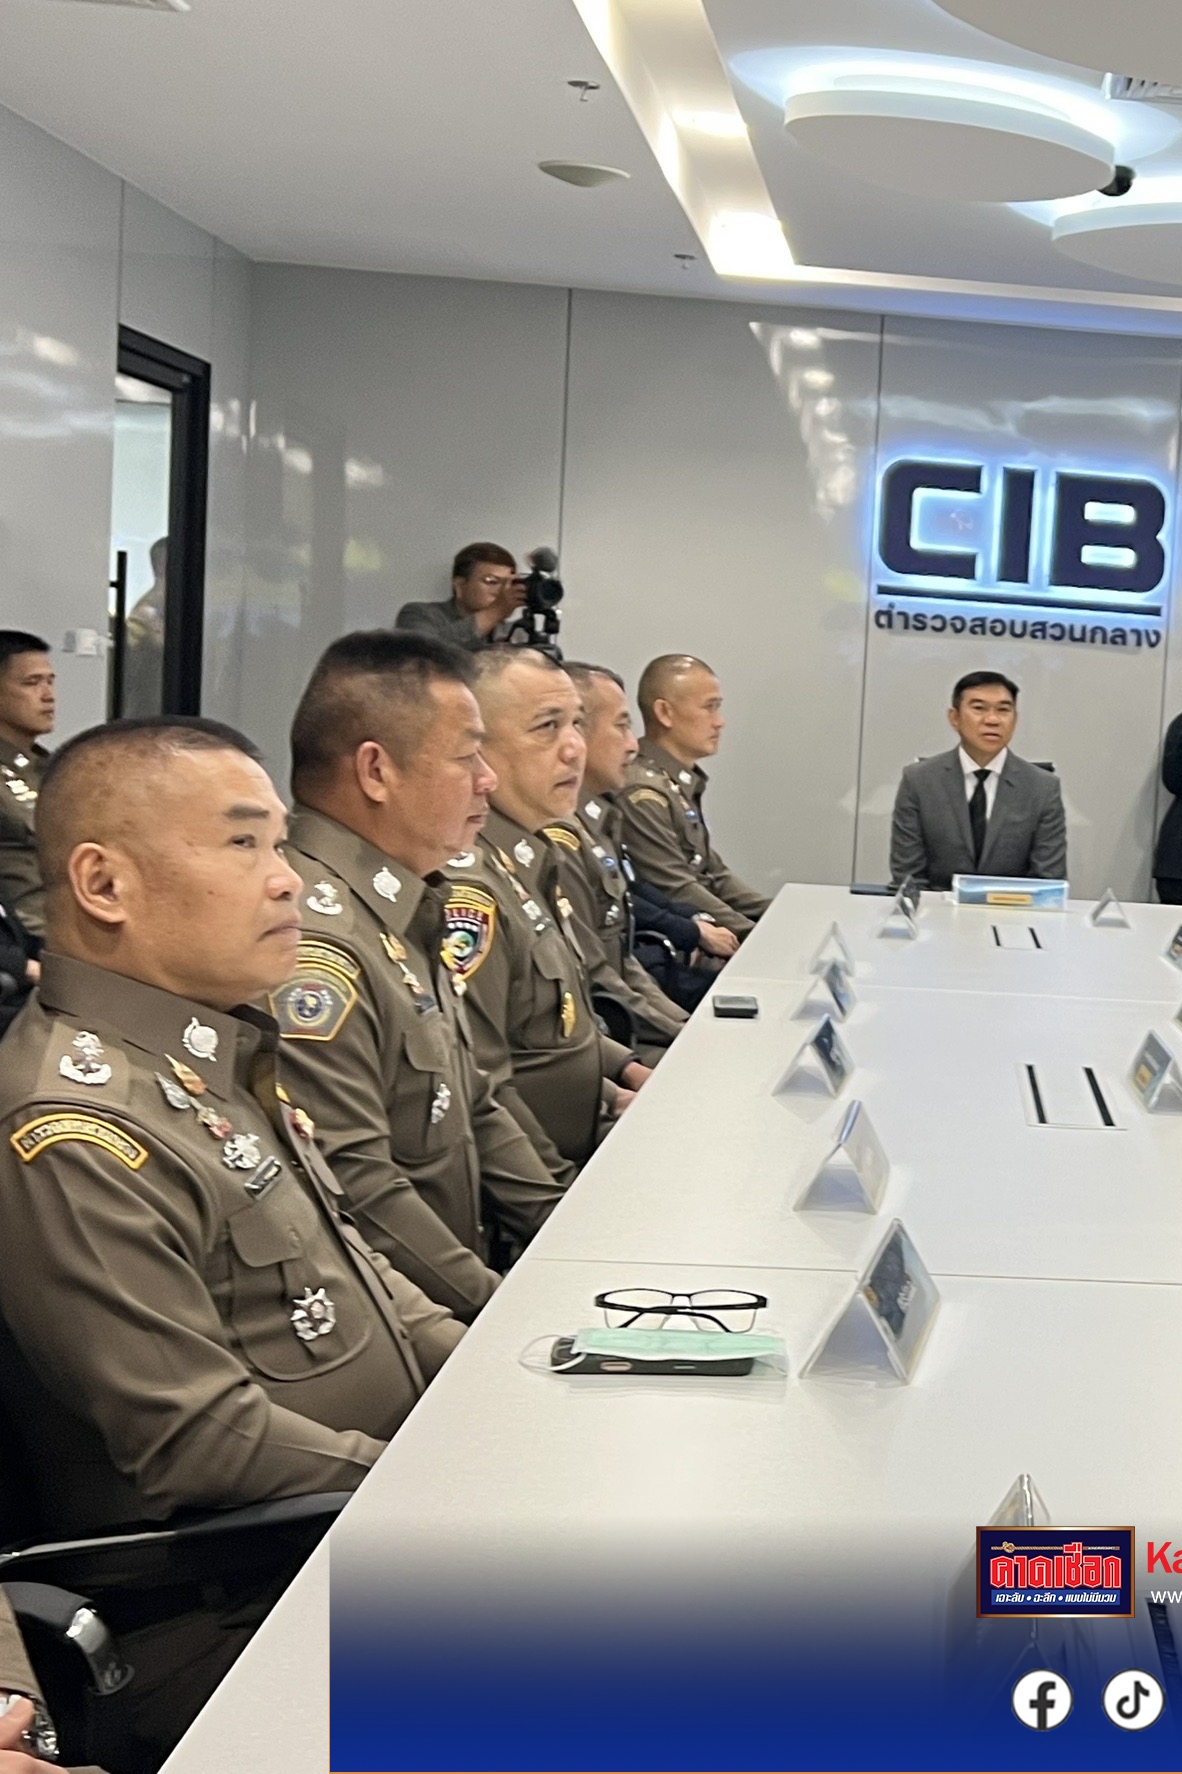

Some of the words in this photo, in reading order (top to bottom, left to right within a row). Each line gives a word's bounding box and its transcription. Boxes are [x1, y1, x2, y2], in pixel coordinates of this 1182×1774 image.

[879, 458, 1166, 594] CIB
[874, 602, 1162, 649] ตำรวจสอบสวนกลาง
